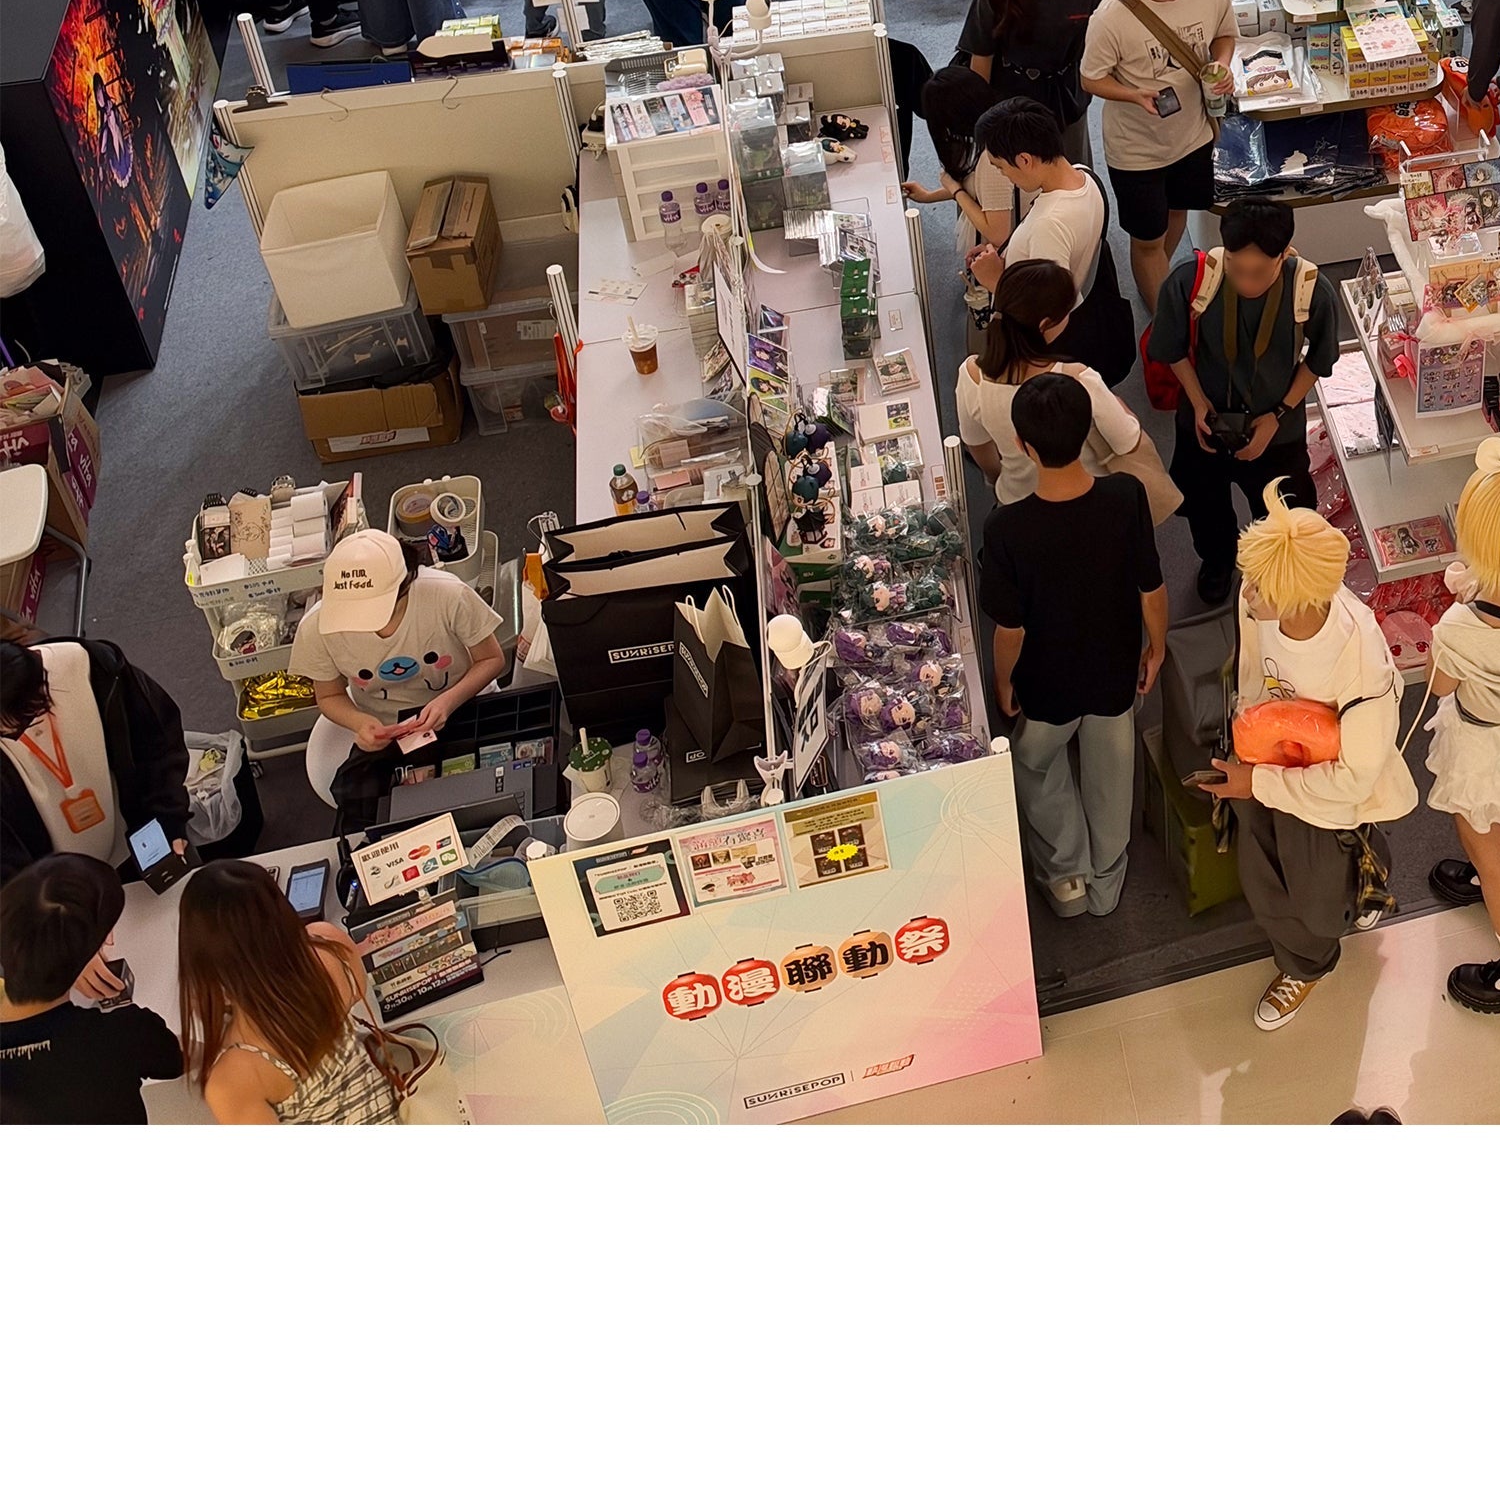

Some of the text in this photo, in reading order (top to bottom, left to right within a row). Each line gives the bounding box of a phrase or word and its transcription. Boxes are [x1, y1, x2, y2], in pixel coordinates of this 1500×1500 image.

[340, 570, 351, 579] No
[333, 579, 374, 590] Just Food.
[386, 857, 405, 869] VISA
[667, 925, 945, 1016] 動漫聯動祭
